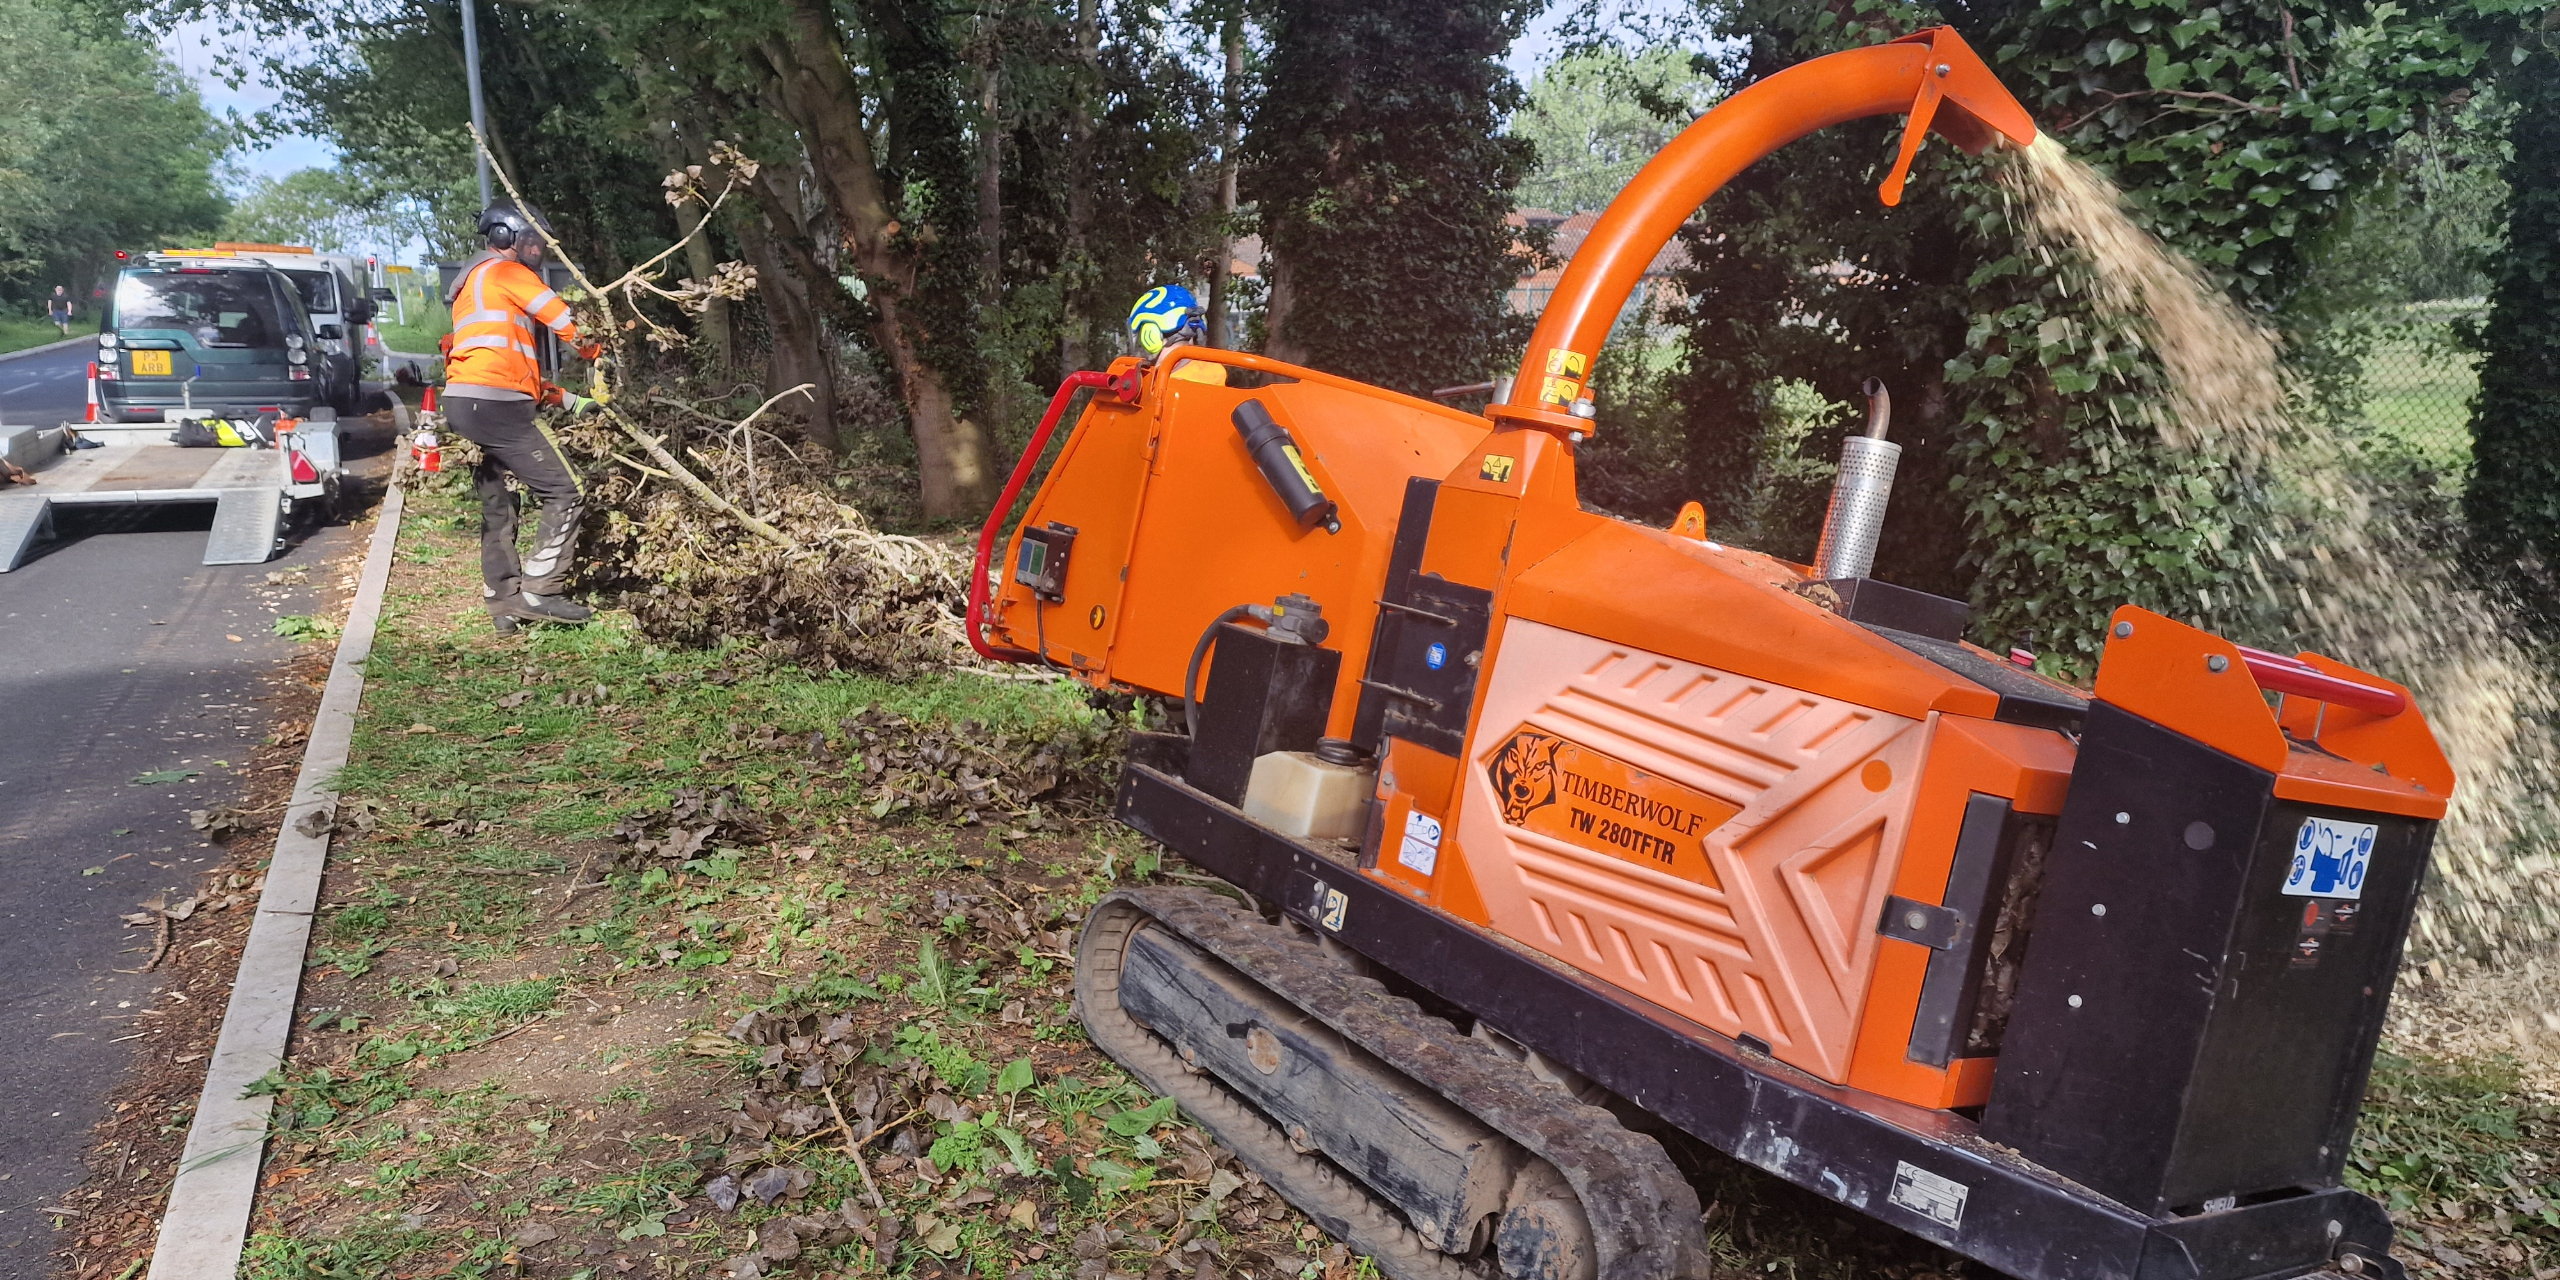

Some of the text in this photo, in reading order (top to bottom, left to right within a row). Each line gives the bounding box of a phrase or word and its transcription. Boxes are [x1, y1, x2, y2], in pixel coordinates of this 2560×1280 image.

[141, 363, 164, 373] ARB
[143, 351, 159, 361] P3
[1562, 770, 1704, 837] TIMBERWOLF
[1569, 807, 1676, 865] TW 280TFTR
